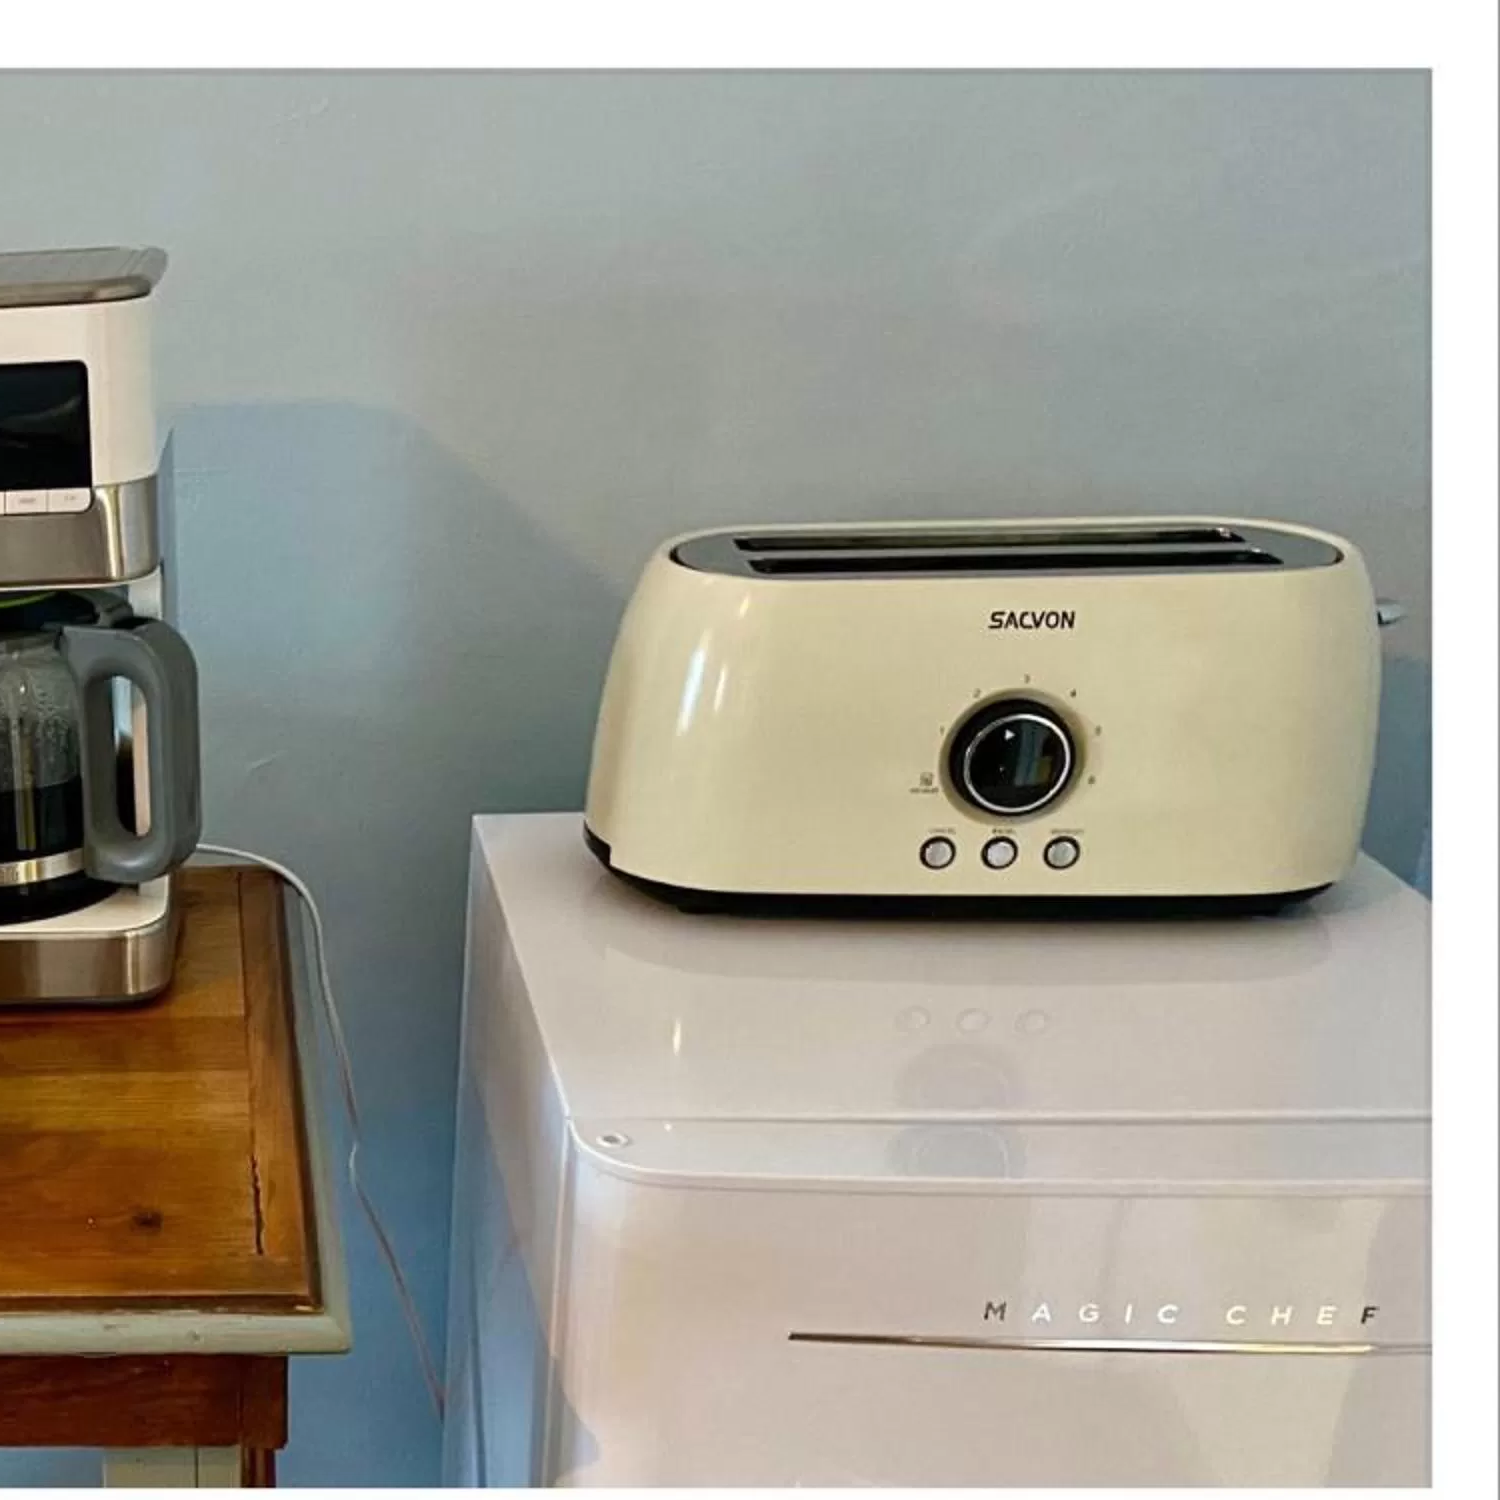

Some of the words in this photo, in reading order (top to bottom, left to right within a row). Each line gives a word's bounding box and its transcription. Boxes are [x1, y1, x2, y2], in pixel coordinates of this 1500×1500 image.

[988, 610, 1076, 630] SACVON
[983, 1302, 1179, 1324] MAGIC
[1226, 1305, 1380, 1325] CHEF
